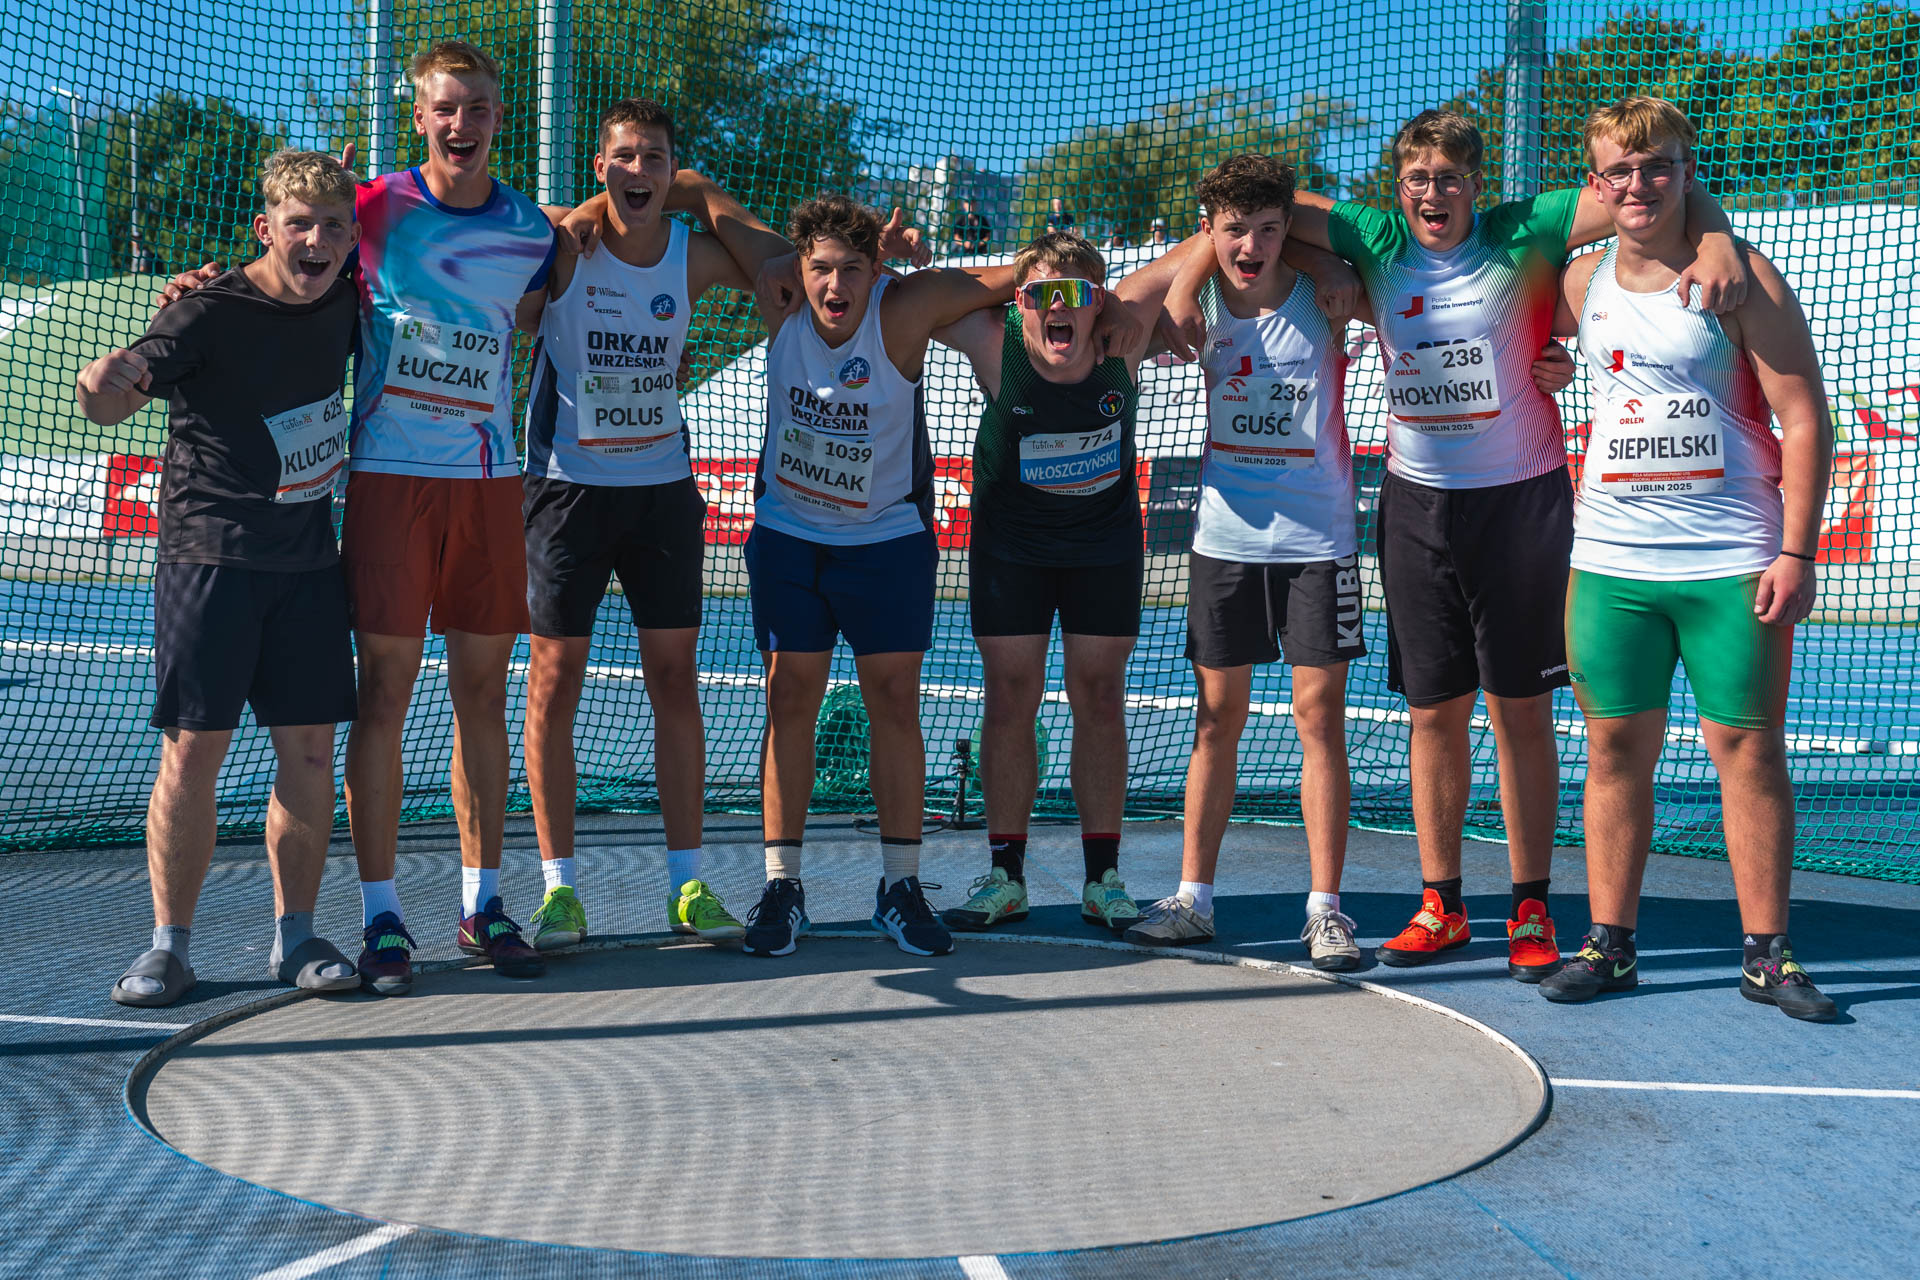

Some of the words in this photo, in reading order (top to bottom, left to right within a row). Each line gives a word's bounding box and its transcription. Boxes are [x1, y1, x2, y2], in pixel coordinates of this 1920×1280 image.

[452, 330, 500, 356] 1073
[588, 330, 669, 355] ORKAN
[588, 352, 666, 369] WRZEŚNIA
[1441, 346, 1483, 369] 238
[397, 354, 490, 391] ŁUCZAK
[631, 373, 674, 394] 1040
[1269, 383, 1308, 402] 236
[1389, 379, 1493, 406] HOŁYŃSKI
[789, 386, 869, 417] ORKAN
[1222, 394, 1249, 402] ORLEN
[1667, 398, 1711, 419] 240
[323, 396, 342, 423] 625
[410, 401, 442, 414] LUBLIN
[443, 407, 466, 418] 2025
[595, 406, 664, 427] POLUS
[1232, 412, 1292, 436] GUŚĆ
[1619, 417, 1644, 425] ORLEN
[604, 446, 633, 454] LUBLIN
[1079, 429, 1113, 450] 774
[1607, 434, 1717, 460] SIEPIELSKI
[284, 428, 347, 475] KLUCZNY
[825, 441, 873, 463] 1039
[1234, 455, 1263, 465] LUBLIN
[1264, 457, 1286, 466] 2025
[780, 452, 865, 493] PAWLAK
[1024, 448, 1117, 481] WŁOSZCZYŃSKI
[1631, 483, 1665, 492] LUBLIN
[1666, 482, 1692, 491] 2025
[794, 492, 821, 506] LUBLIN
[822, 501, 841, 512] 2025
[1512, 923, 1544, 941] NIKE
